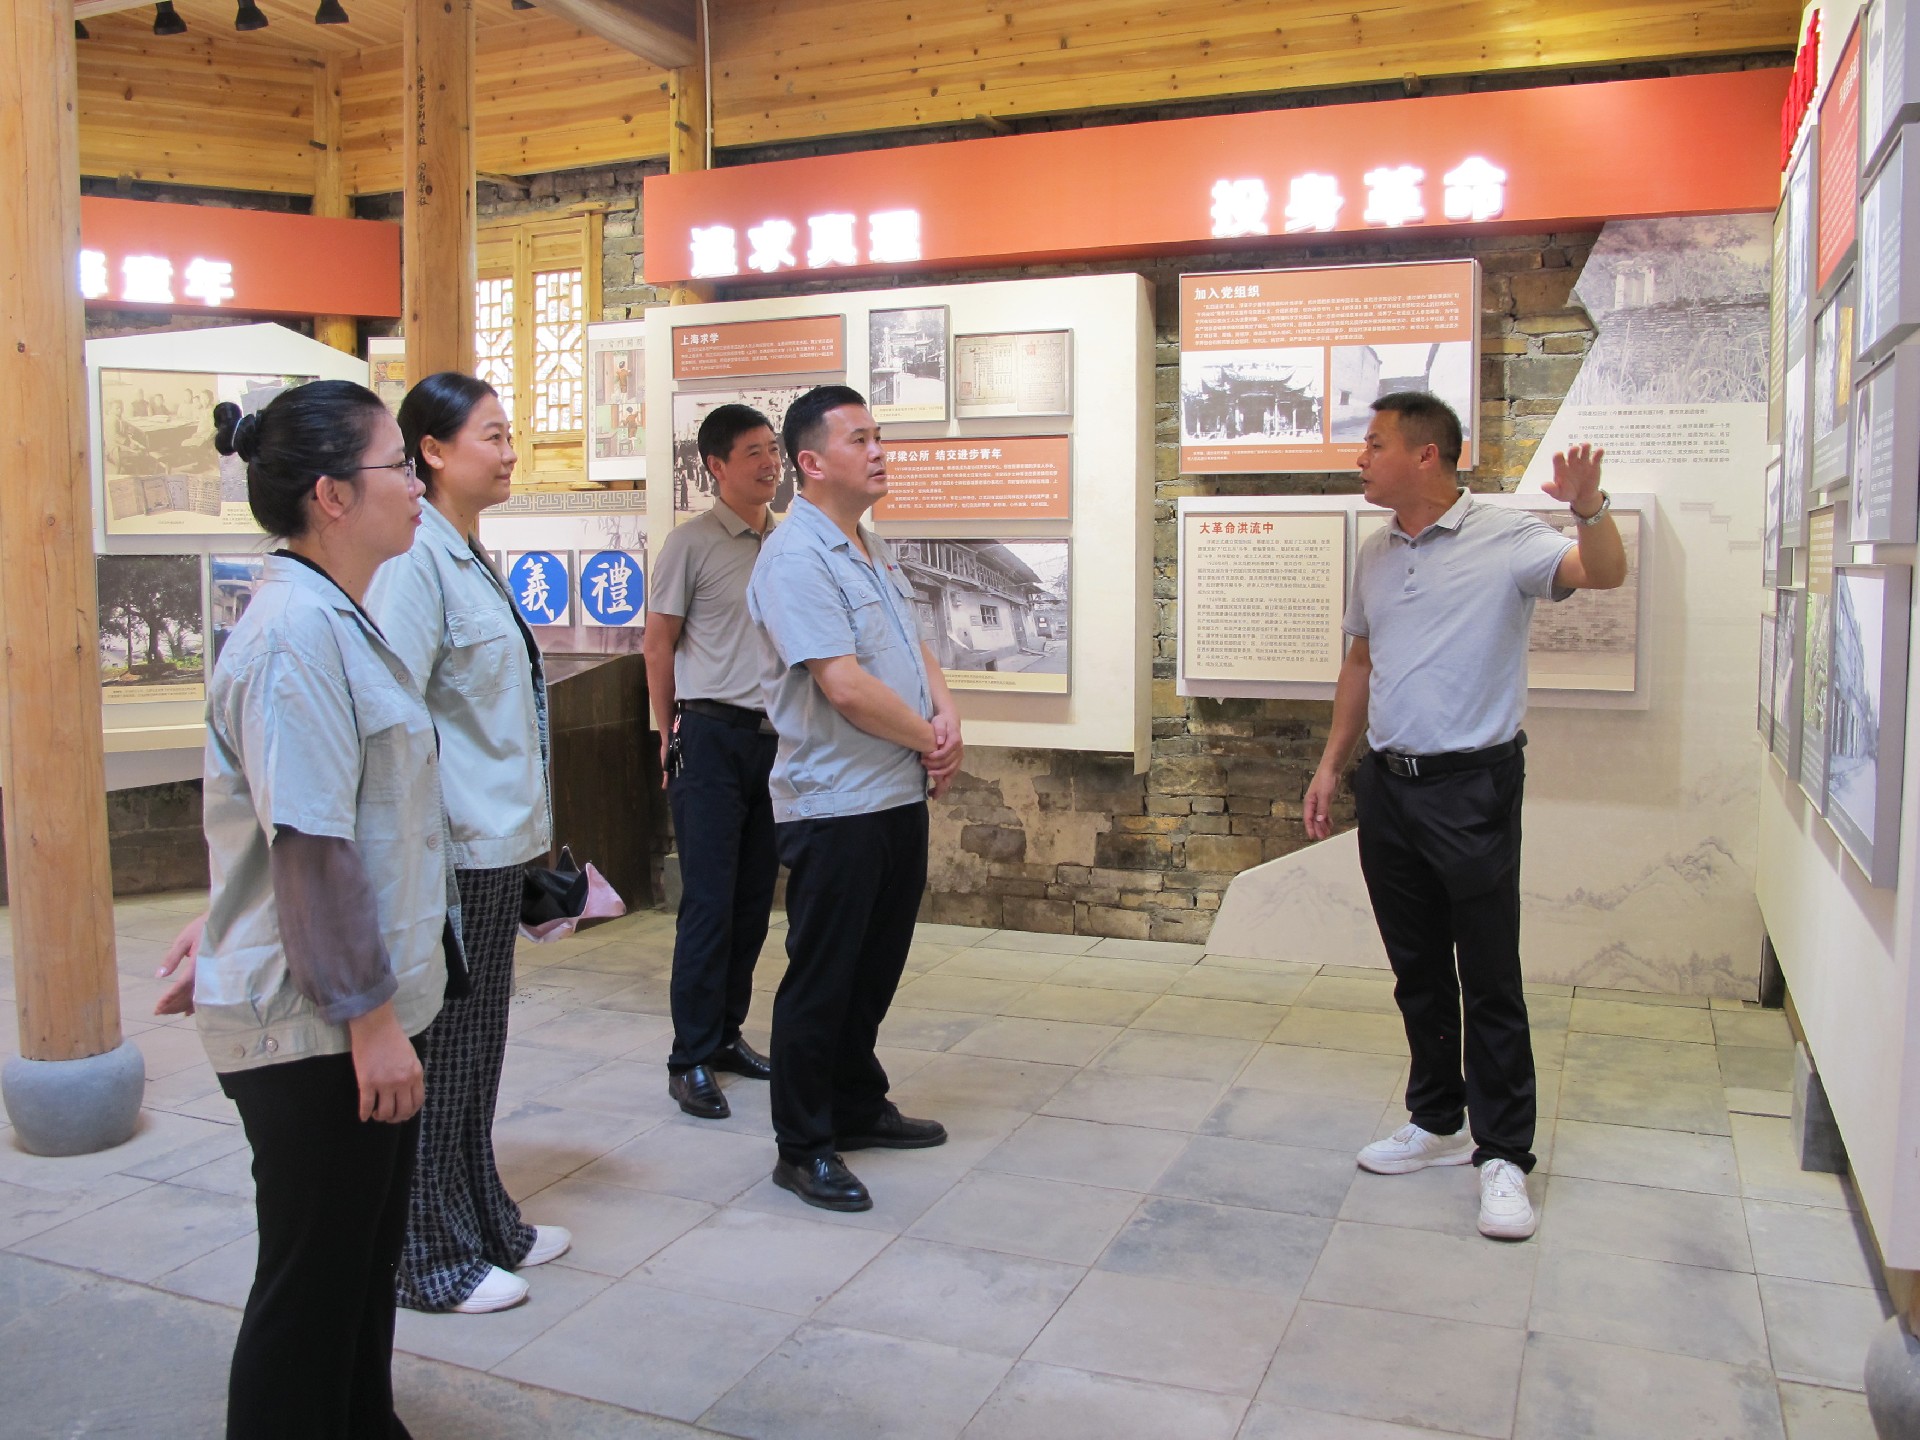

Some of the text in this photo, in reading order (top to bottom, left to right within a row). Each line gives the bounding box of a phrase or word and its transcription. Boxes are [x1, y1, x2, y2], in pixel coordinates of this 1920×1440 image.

[1211, 156, 1506, 238] 投身革命
[691, 210, 919, 278] 追求真理
[1194, 285, 1260, 300] 加入党组织
[680, 333, 719, 346] 上海求学
[886, 448, 1002, 462] 浮梁公所 结交进步青年
[1199, 521, 1274, 534] 大革命洪流中
[521, 556, 555, 621] 義
[590, 556, 633, 614] 禮
